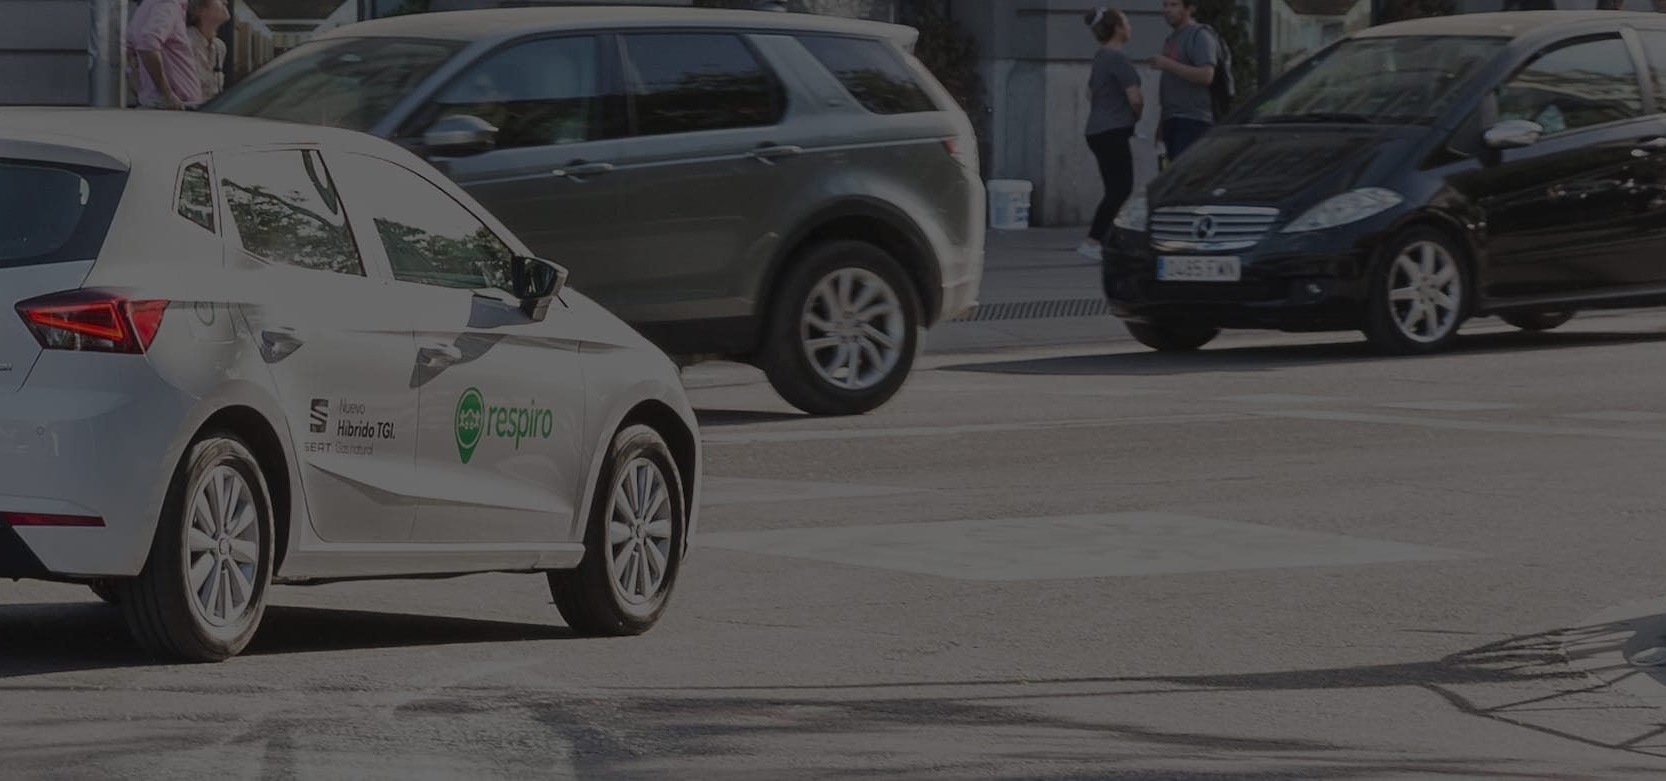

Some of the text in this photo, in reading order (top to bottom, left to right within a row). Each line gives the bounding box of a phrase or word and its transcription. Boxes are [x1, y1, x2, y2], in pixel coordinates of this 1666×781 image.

[339, 398, 366, 415] Nuevo
[487, 398, 553, 450] respiro
[303, 442, 332, 454] SEAT
